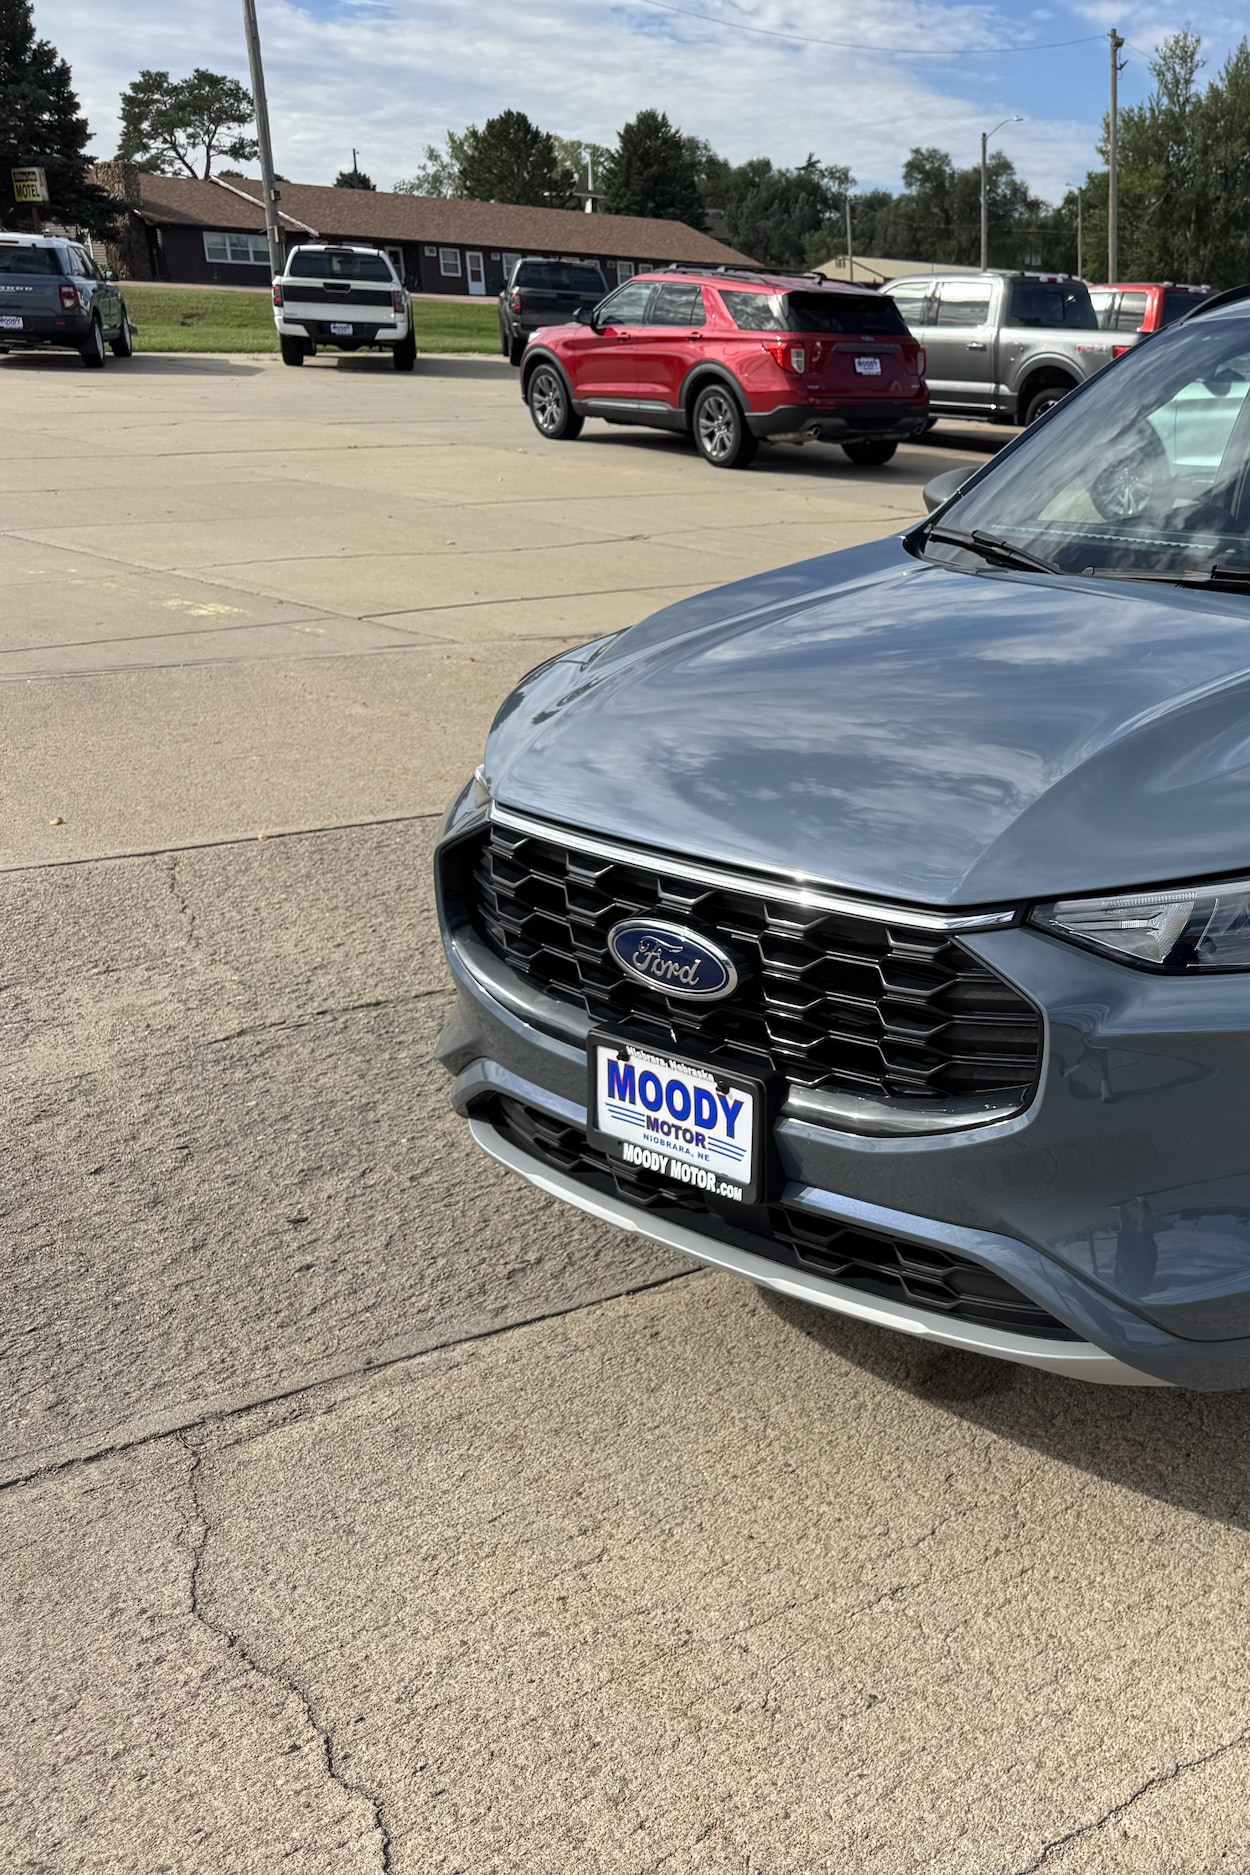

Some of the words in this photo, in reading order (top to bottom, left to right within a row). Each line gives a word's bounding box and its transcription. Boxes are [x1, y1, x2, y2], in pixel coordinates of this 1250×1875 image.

[16, 184, 40, 198] MOTEL
[632, 935, 702, 986] Ford
[626, 1045, 668, 1068] Niobrara,
[607, 1058, 744, 1139] MOODY
[643, 1133, 694, 1158] NIOBRARA,
[697, 1151, 710, 1162] NE
[646, 1114, 708, 1149] MOTOR
[623, 1142, 669, 1174] MOODY
